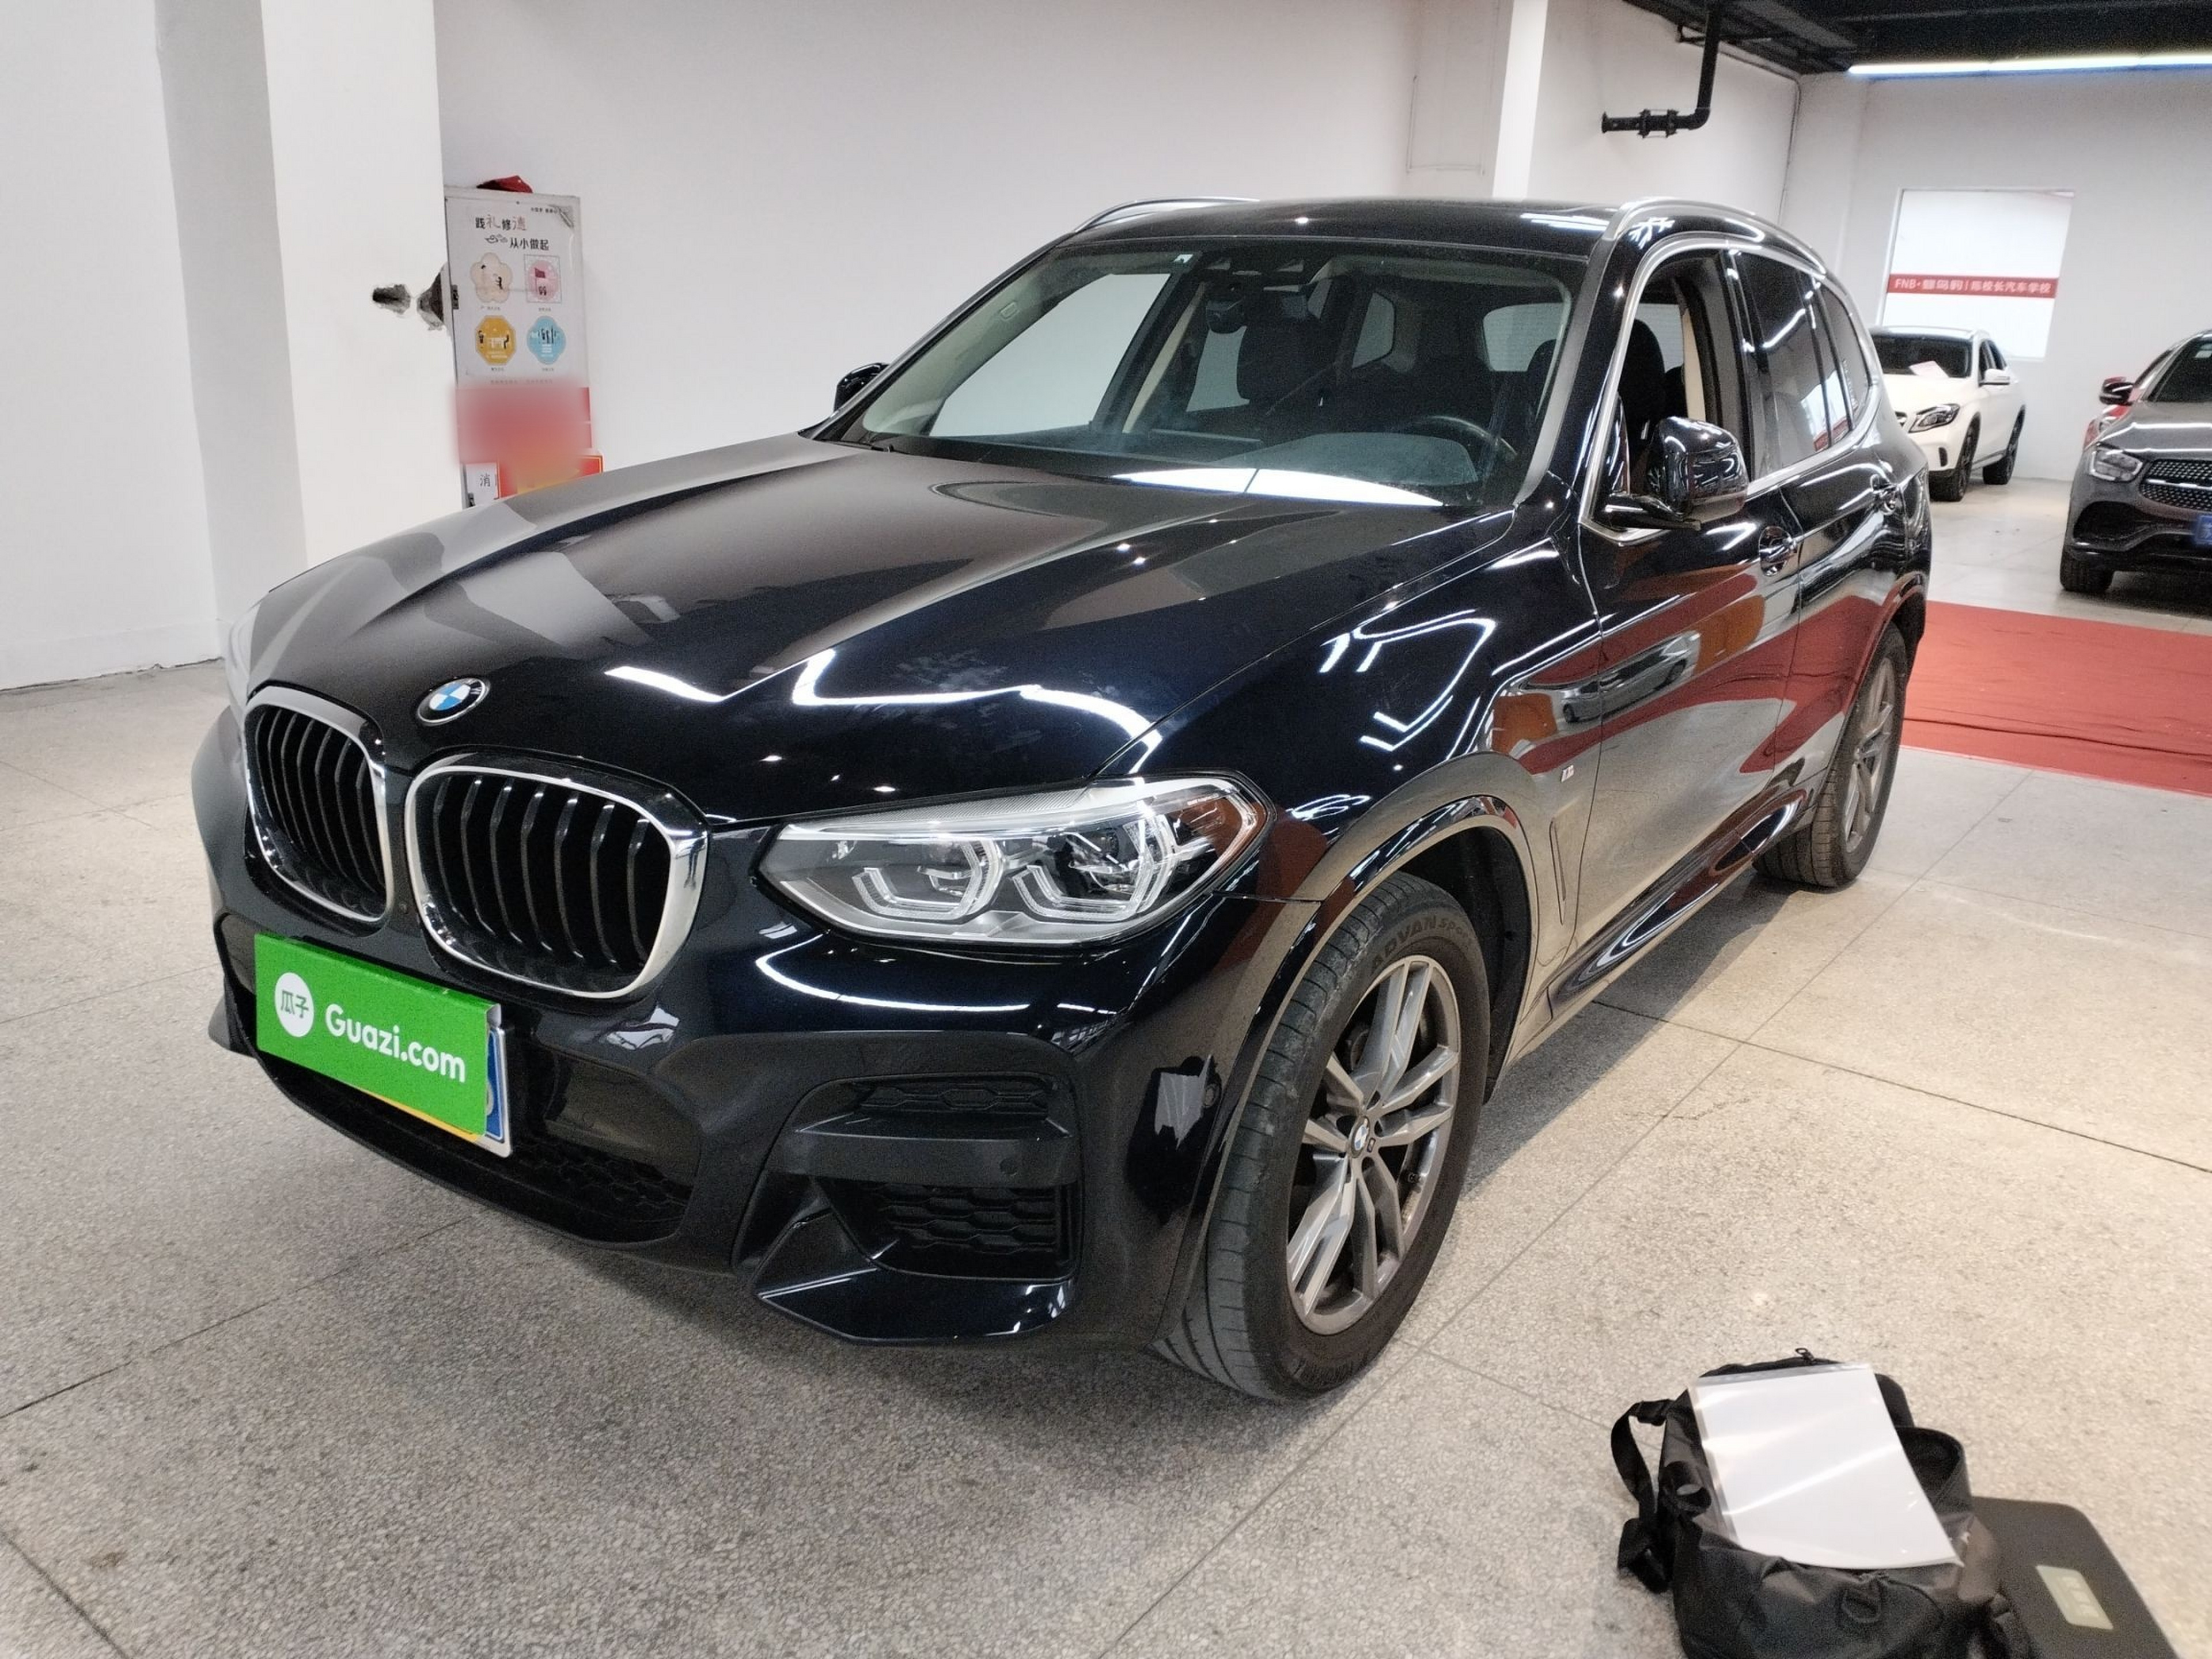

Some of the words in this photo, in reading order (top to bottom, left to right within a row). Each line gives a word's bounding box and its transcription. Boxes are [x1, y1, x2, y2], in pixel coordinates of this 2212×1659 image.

[509, 237, 549, 251] 从小做起
[1372, 915, 1438, 969] ADVAN
[280, 989, 309, 1019] 瓜子
[324, 1003, 467, 1084] Guazi.com
